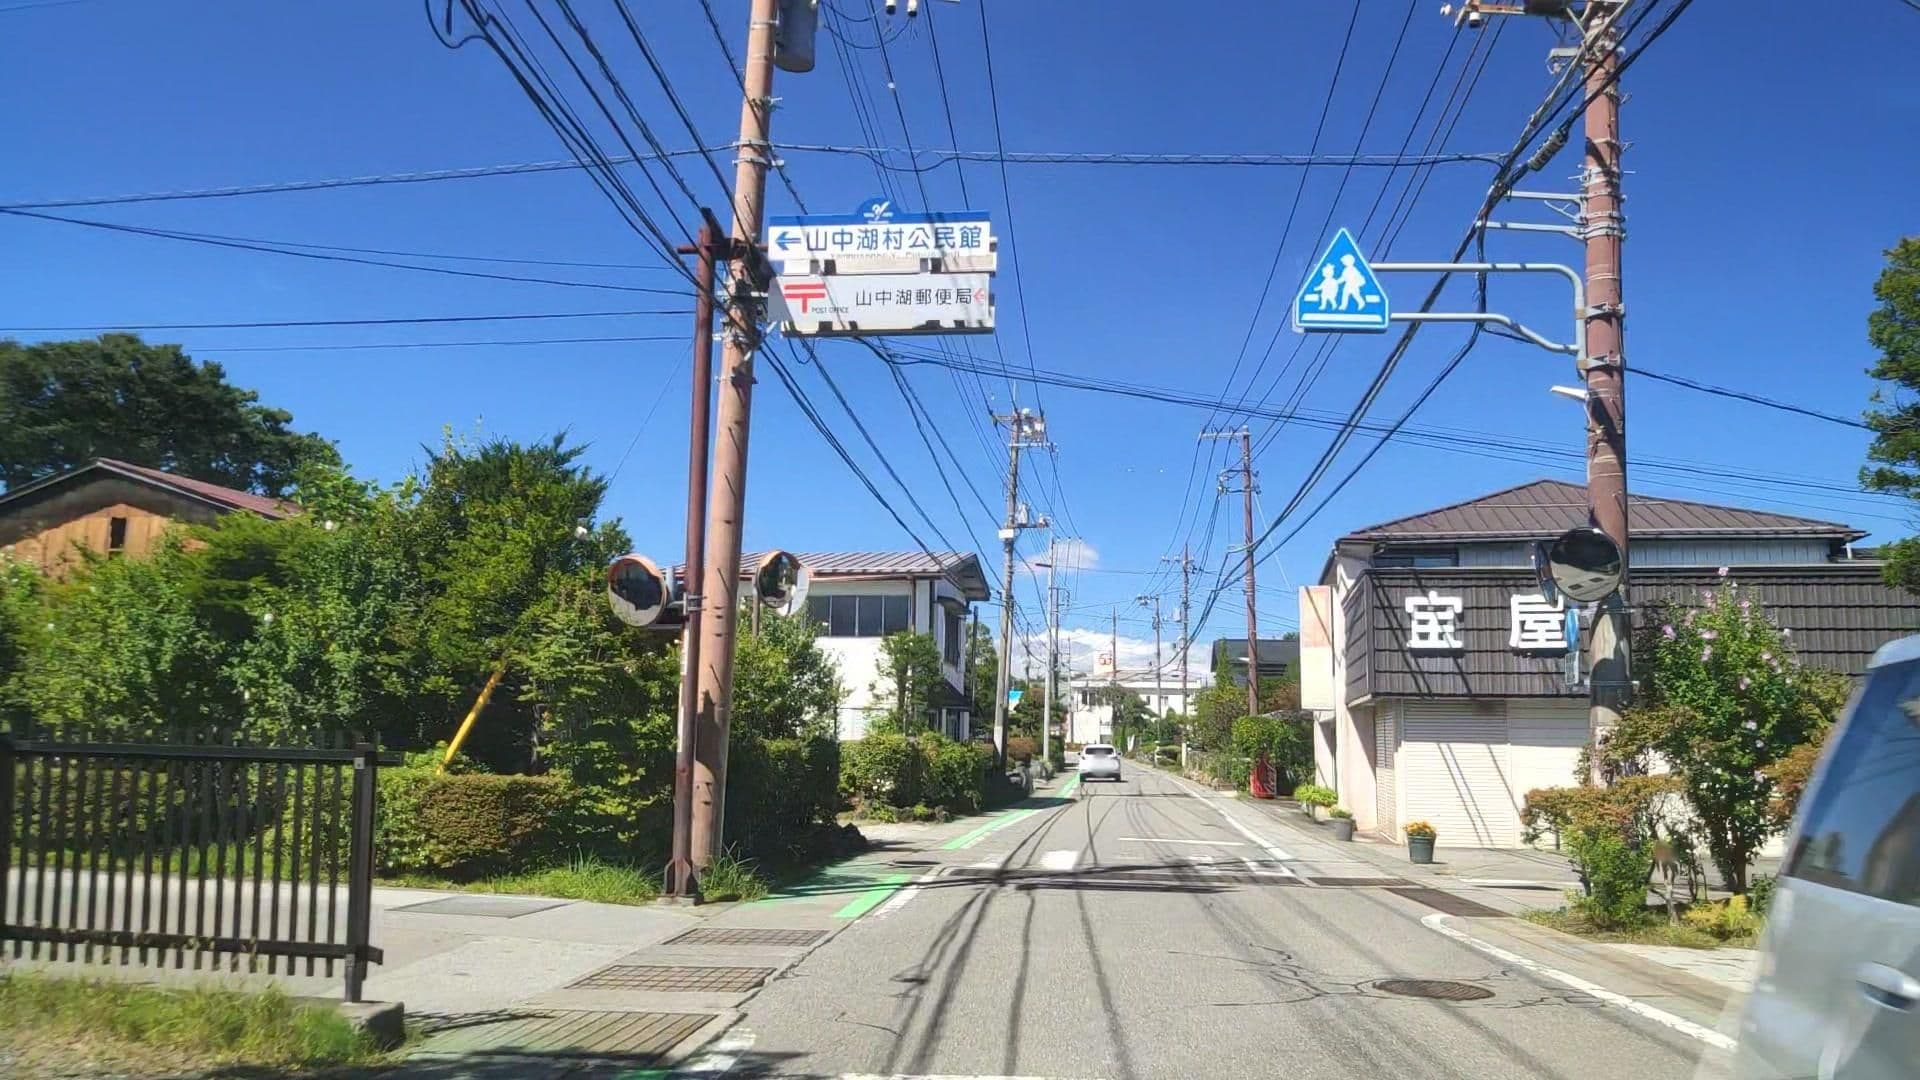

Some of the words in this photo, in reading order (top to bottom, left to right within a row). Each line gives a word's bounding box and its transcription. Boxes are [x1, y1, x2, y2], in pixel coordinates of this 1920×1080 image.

[806, 225, 982, 251] 山中湖村公民館
[855, 288, 972, 306] 山中湖郵便局
